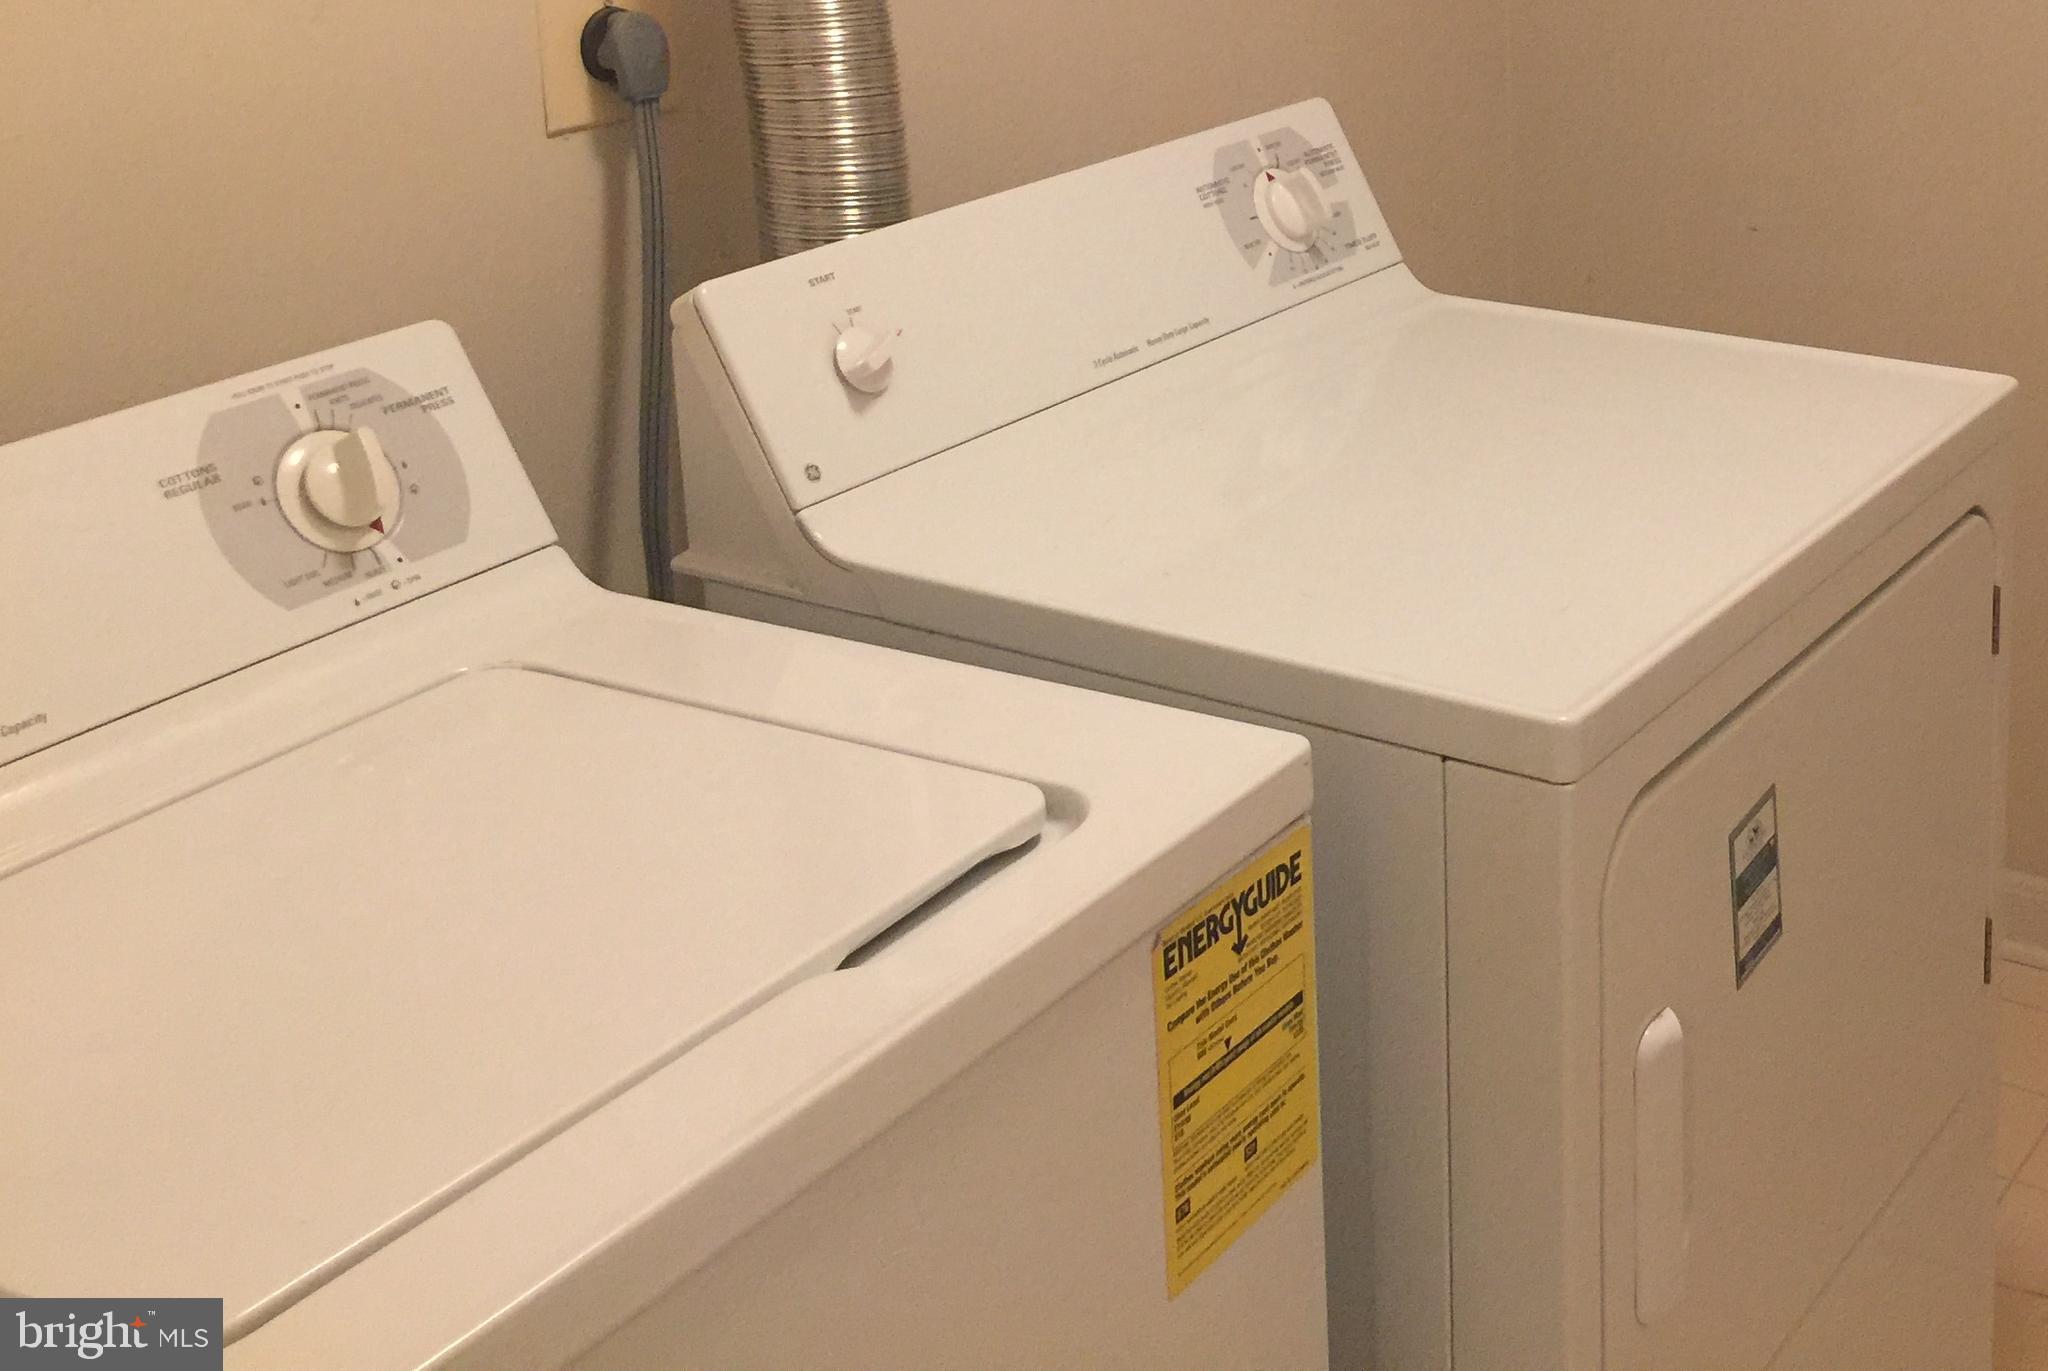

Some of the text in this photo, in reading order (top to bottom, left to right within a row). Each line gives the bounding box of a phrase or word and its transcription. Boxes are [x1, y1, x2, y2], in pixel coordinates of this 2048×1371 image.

[808, 272, 835, 287] START
[382, 386, 449, 415] PERMANENT
[420, 396, 456, 414] PRESS
[158, 462, 218, 489] COTTONS
[163, 473, 223, 500] REGULAR
[0, 713, 47, 737] Capacity
[1162, 850, 1302, 981] ENERGYGUIDE
[1168, 1004, 1194, 1032] Compare
[1208, 977, 1227, 1000] Energy
